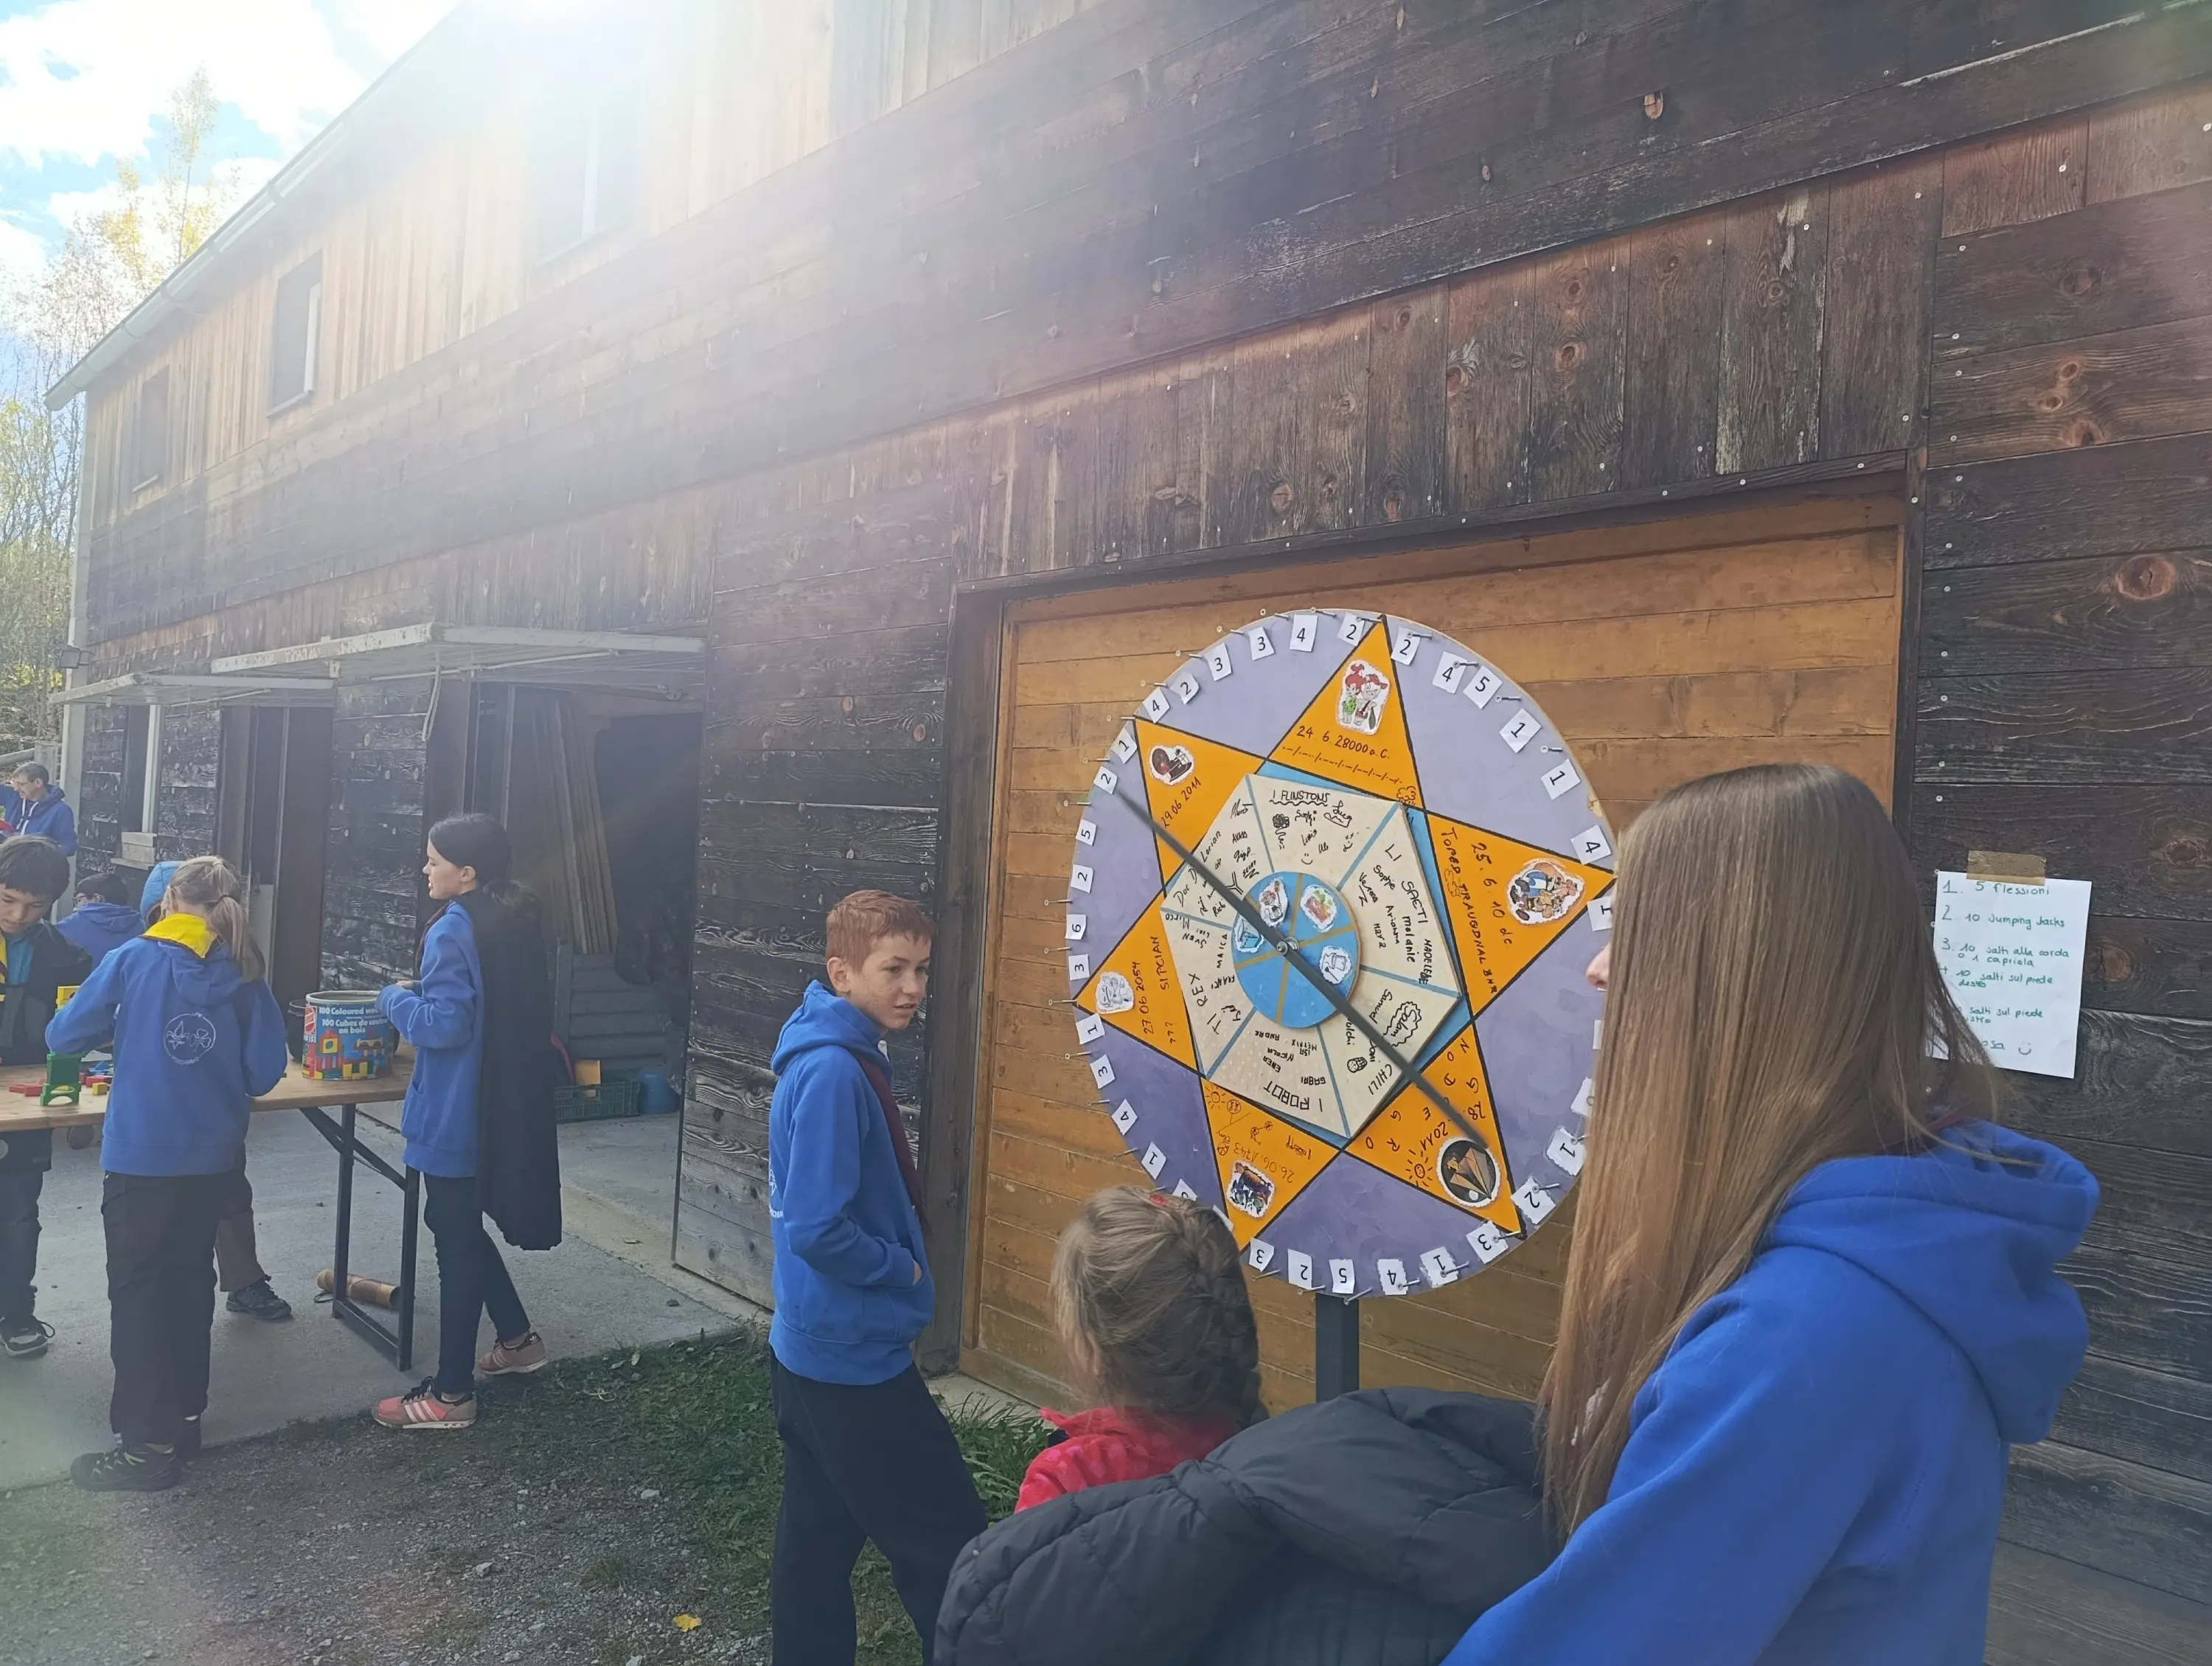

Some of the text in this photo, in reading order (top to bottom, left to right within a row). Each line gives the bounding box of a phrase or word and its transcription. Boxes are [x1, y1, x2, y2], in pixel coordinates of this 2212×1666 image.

[1296, 628, 1306, 642] 4
[1346, 624, 1357, 640] 2
[1257, 636, 1265, 650] 3
[1399, 639, 1411, 656] 2
[1214, 657, 1223, 672] 3
[1441, 666, 1454, 682] 4
[1180, 681, 1192, 695] 2
[1475, 676, 1490, 692] 5
[1152, 699, 1160, 712] 4
[1510, 721, 1526, 738] 1
[1119, 739, 1129, 752] 1
[1100, 773, 1112, 784] 2
[1549, 770, 1565, 785] 1
[1281, 790, 1331, 803] FLINSTONS
[1080, 829, 1091, 840] 5
[1585, 841, 1601, 853] 4
[1077, 871, 1088, 881] 2
[1975, 881, 1985, 892] 5
[1993, 882, 2050, 895] flessioni
[1965, 913, 1980, 922] 10
[1071, 923, 1082, 932] 6
[1959, 943, 1975, 952] 10
[2013, 945, 2034, 957] alla
[1074, 963, 1085, 973] 3
[2008, 973, 2023, 982] sul
[2025, 975, 2053, 985] piede
[1188, 972, 1208, 1007] REX
[319, 1006, 330, 1015] 100
[331, 1006, 364, 1016] Coloured
[2015, 1008, 2044, 1018] piede
[321, 1018, 335, 1027] 100
[335, 1019, 358, 1027] Cubes
[1088, 1024, 1097, 1035] 1
[349, 1026, 366, 1034] bois
[1097, 1065, 1108, 1077] 3
[1301, 1075, 1326, 1086] GABRI
[1367, 1063, 1394, 1095] CHILI
[1263, 1080, 1310, 1111] ROBOT
[1120, 1110, 1130, 1121] 4
[1559, 1142, 1576, 1158] 1
[1149, 1151, 1158, 1165] 1
[1524, 1191, 1540, 1209] 2
[1477, 1233, 1492, 1251] 3
[1256, 1249, 1265, 1264] 3
[1300, 1264, 1308, 1280] 2
[1338, 1267, 1347, 1283] 5
[1387, 1269, 1397, 1285] 4
